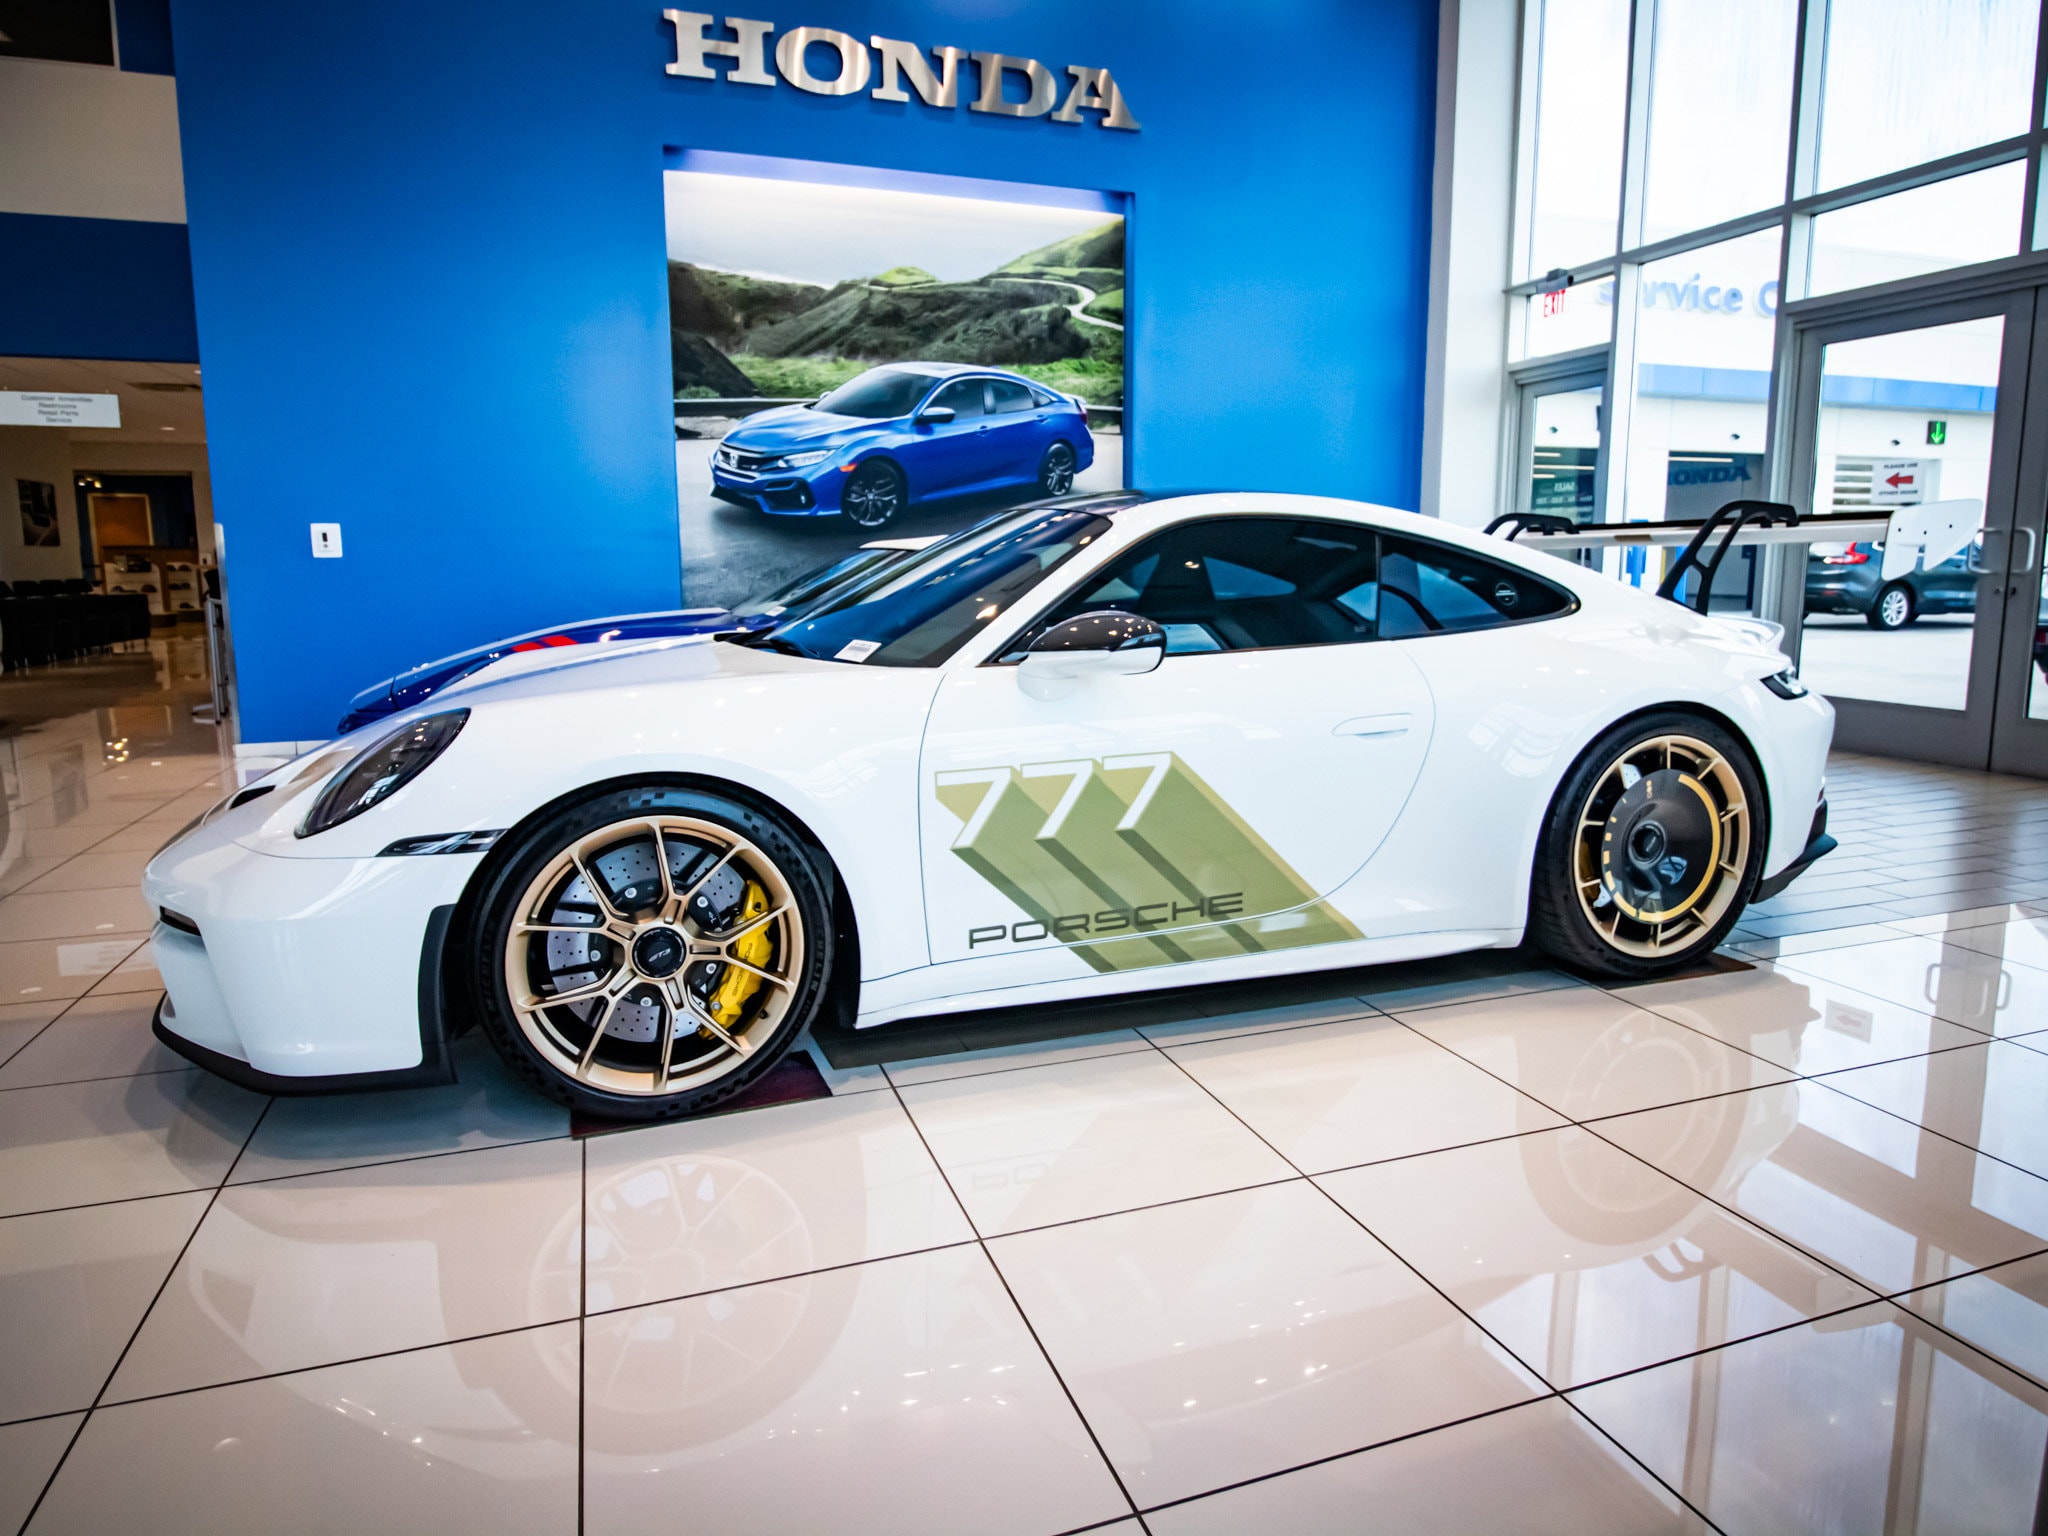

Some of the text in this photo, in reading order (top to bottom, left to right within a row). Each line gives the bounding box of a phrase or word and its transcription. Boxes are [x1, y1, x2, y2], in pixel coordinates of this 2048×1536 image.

[663, 8, 1142, 132] HONDA
[1543, 289, 1567, 318] EXIT
[1597, 273, 1743, 313] Srvice
[1667, 465, 1752, 486] ONDA
[935, 751, 1176, 851] 777
[968, 892, 1244, 950] PORSCHE
